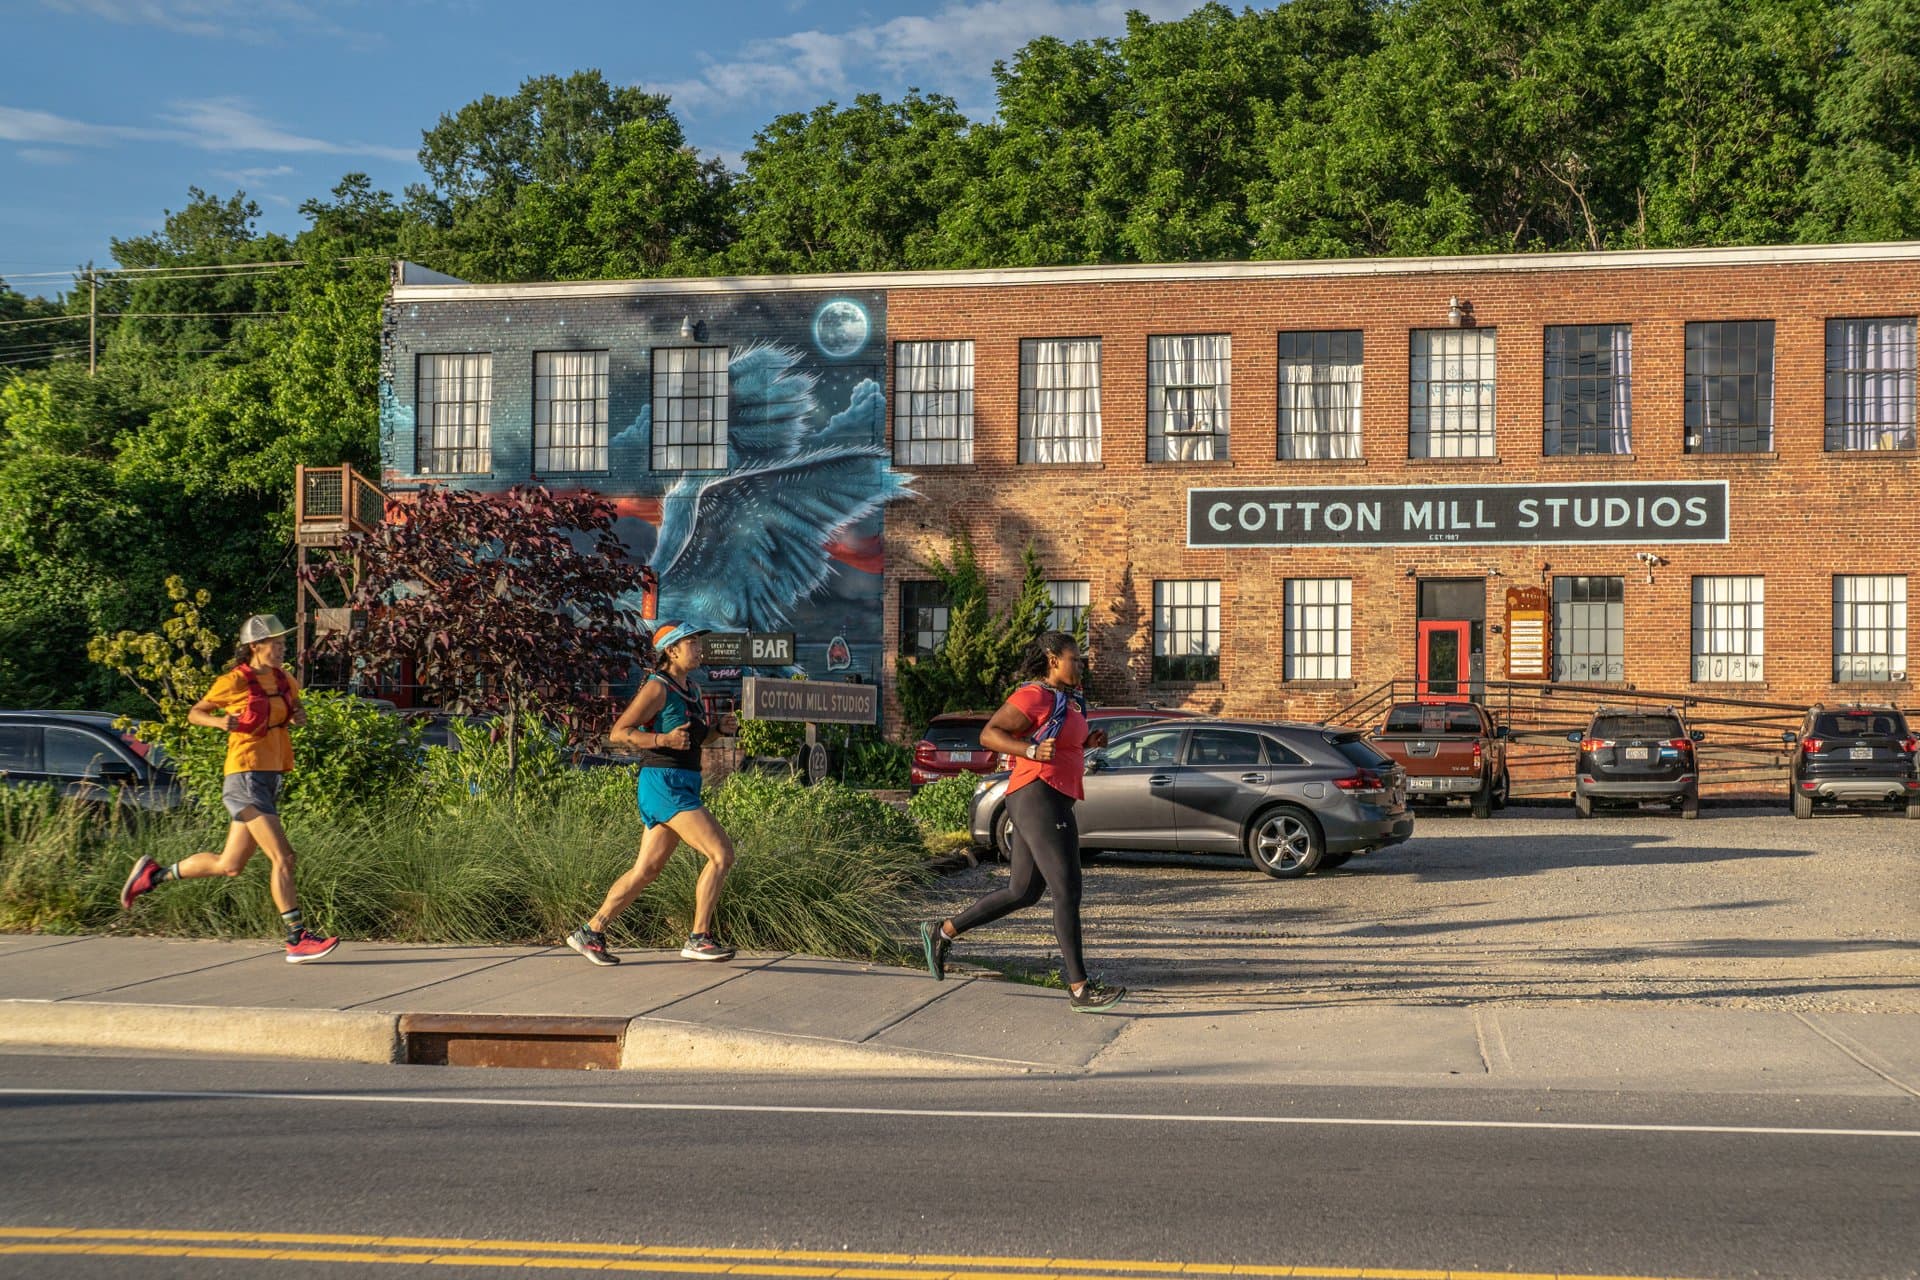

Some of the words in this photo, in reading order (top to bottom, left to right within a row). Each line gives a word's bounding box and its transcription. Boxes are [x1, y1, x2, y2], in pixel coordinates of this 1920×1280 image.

[1208, 502, 1382, 531] COTTON
[1403, 500, 1496, 530] MILL
[1518, 496, 1708, 528] STUDIOS
[752, 639, 789, 658] BAR
[709, 668, 741, 680] open
[761, 690, 803, 709] COTTON
[806, 693, 828, 712] MILL
[831, 695, 870, 713] STUDIOS
[812, 751, 824, 769] 122
